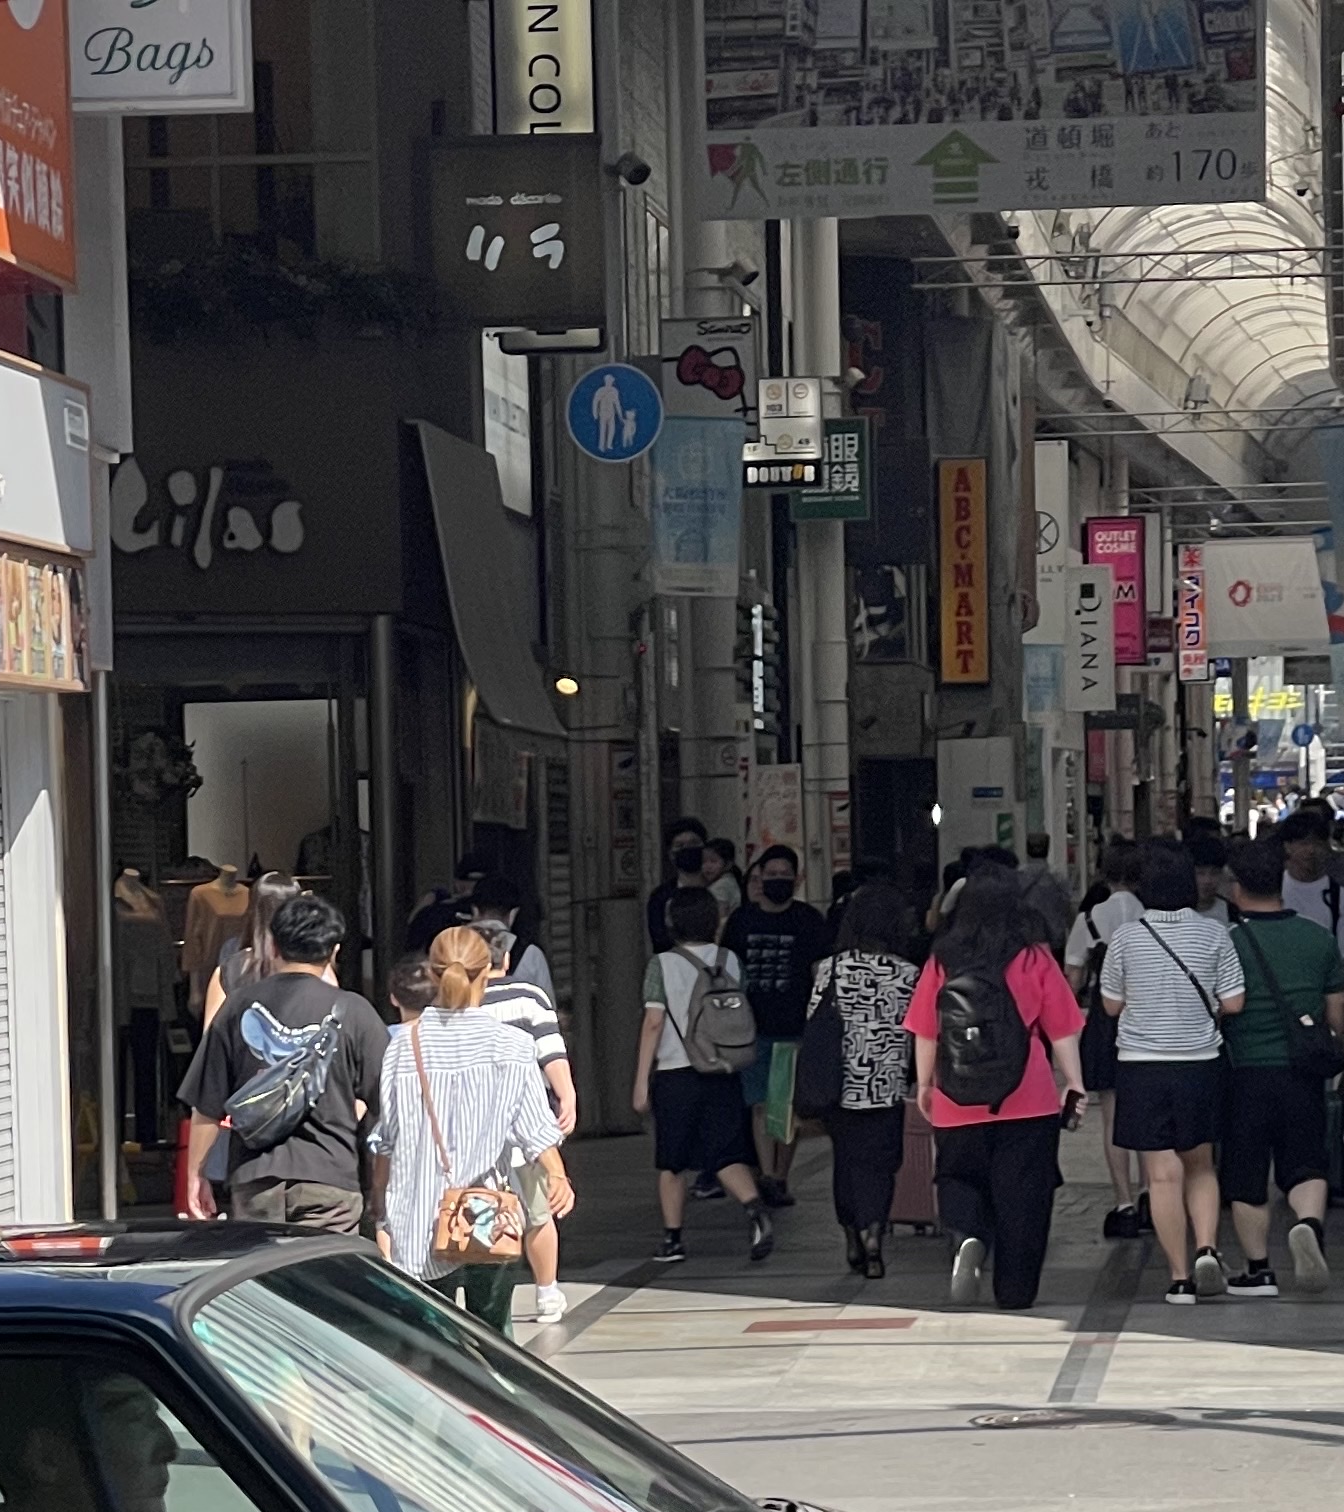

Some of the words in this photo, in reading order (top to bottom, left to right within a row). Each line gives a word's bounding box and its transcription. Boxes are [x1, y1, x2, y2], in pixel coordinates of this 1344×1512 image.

[84, 27, 214, 85] Bags
[775, 157, 889, 187] 左側通行
[1094, 530, 1137, 542] OUTLET
[1096, 543, 1137, 553] COSME
[1075, 583, 1102, 691] DIANA
